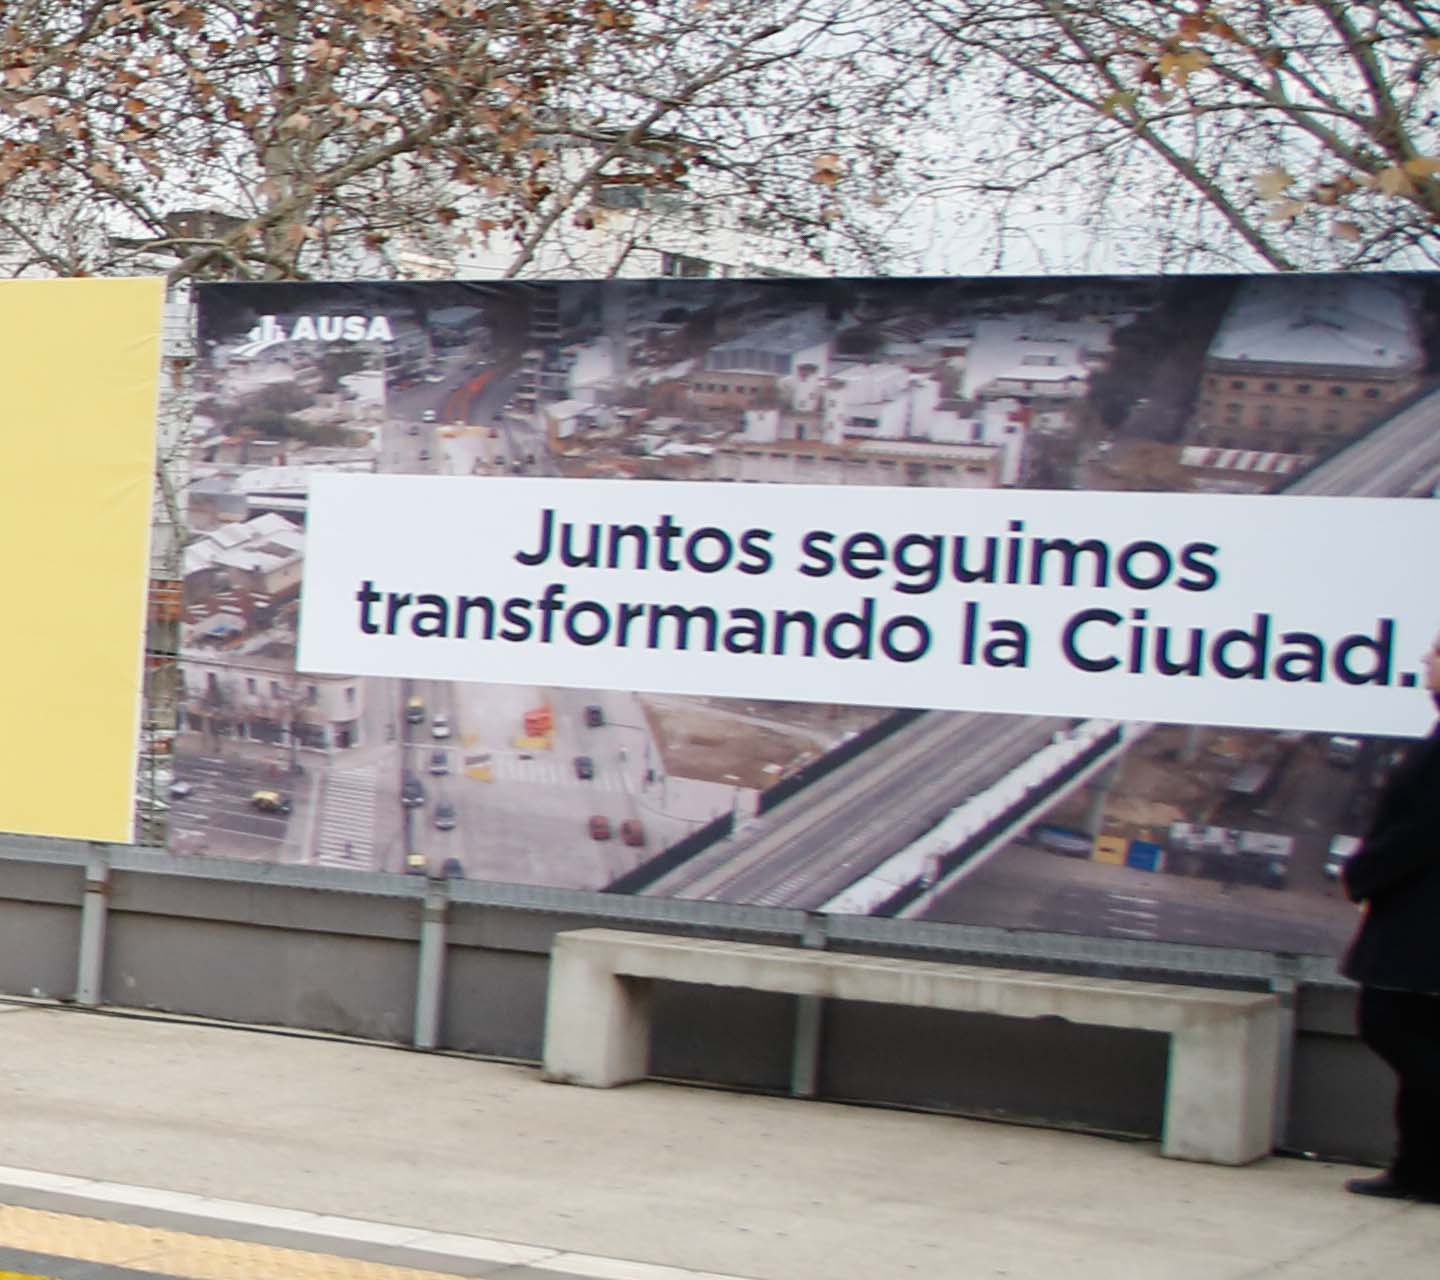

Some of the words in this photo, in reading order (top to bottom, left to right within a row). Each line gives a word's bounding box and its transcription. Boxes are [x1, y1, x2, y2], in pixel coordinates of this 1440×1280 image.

[290, 316, 395, 341] AUSA
[514, 508, 774, 576] Juntos
[797, 520, 1220, 595] seguimos
[356, 580, 931, 663] transformando
[960, 601, 1030, 669] la
[1060, 607, 1418, 688] Ciudad.
